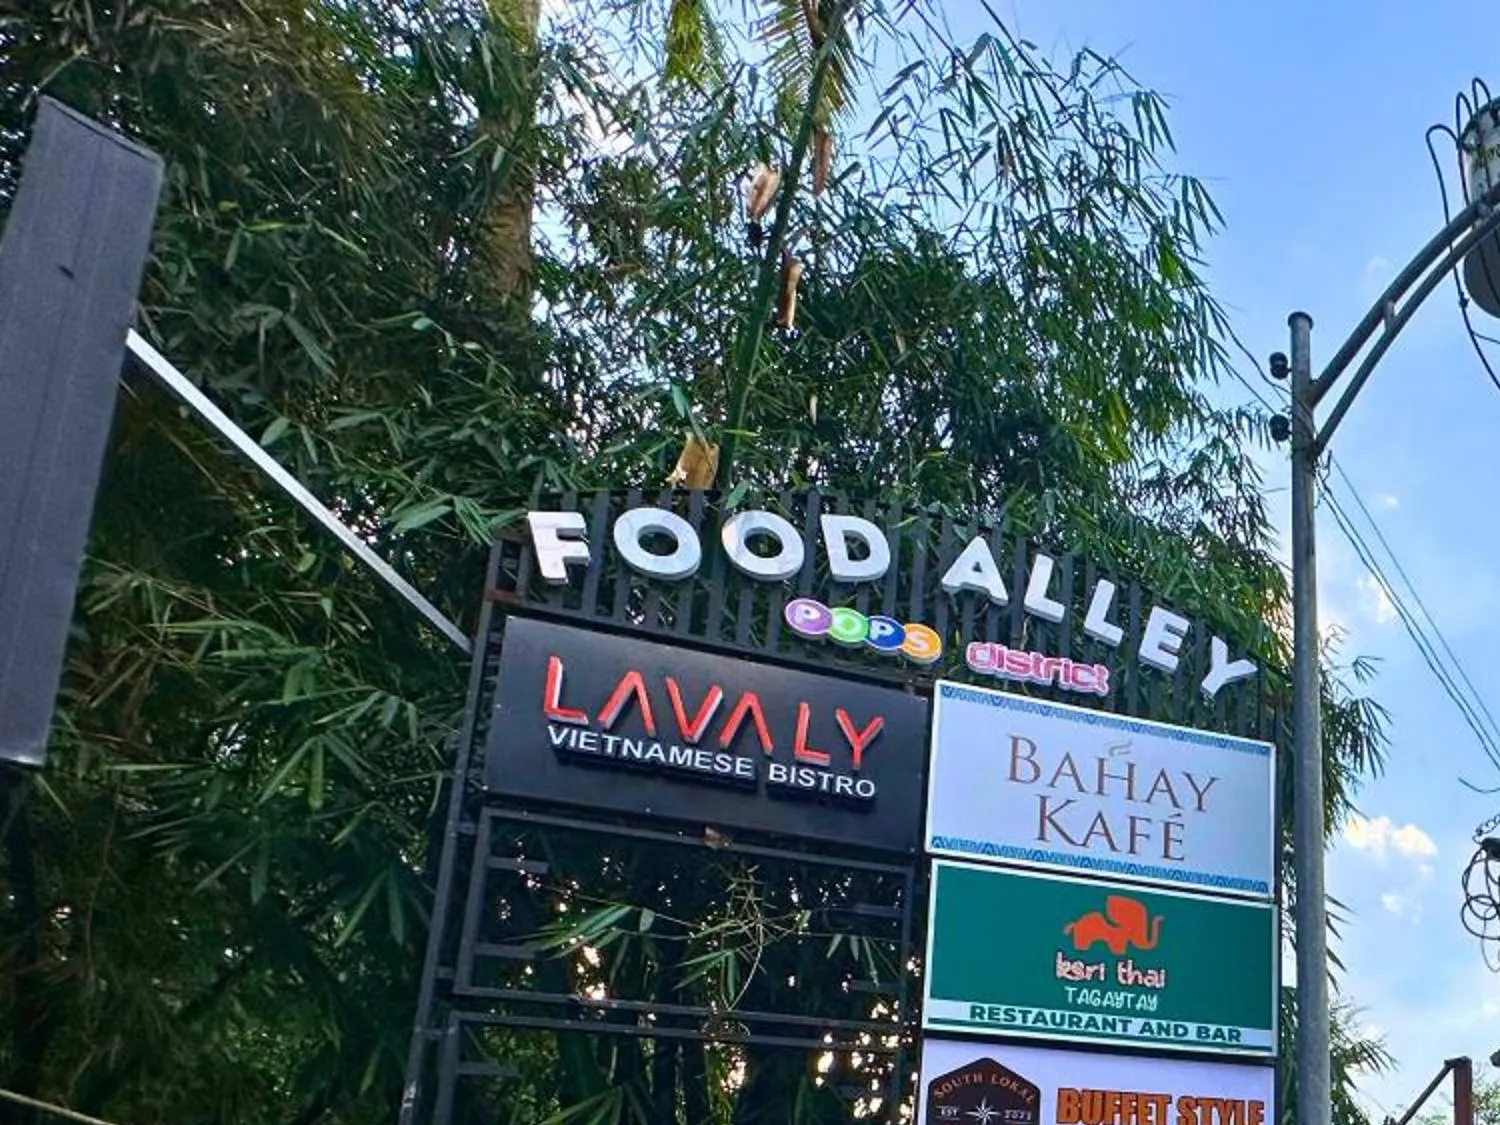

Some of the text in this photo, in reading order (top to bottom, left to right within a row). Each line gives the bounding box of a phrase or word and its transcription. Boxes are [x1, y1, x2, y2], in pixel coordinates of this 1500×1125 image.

[527, 507, 1257, 700] FOOD ALLEY
[788, 600, 1109, 695] POPS district
[543, 655, 884, 770] LAVALY
[548, 724, 876, 799] VIETNAMESE BISTRO
[1007, 735, 1221, 813] BAHAY
[1035, 794, 1187, 862] KAFÉ
[1064, 985, 1158, 1011] TAGAYTAY
[1117, 959, 1166, 988] thai
[969, 1004, 1242, 1043] RESTAURANT AND BAR
[933, 1071, 984, 1099] SOUTH
